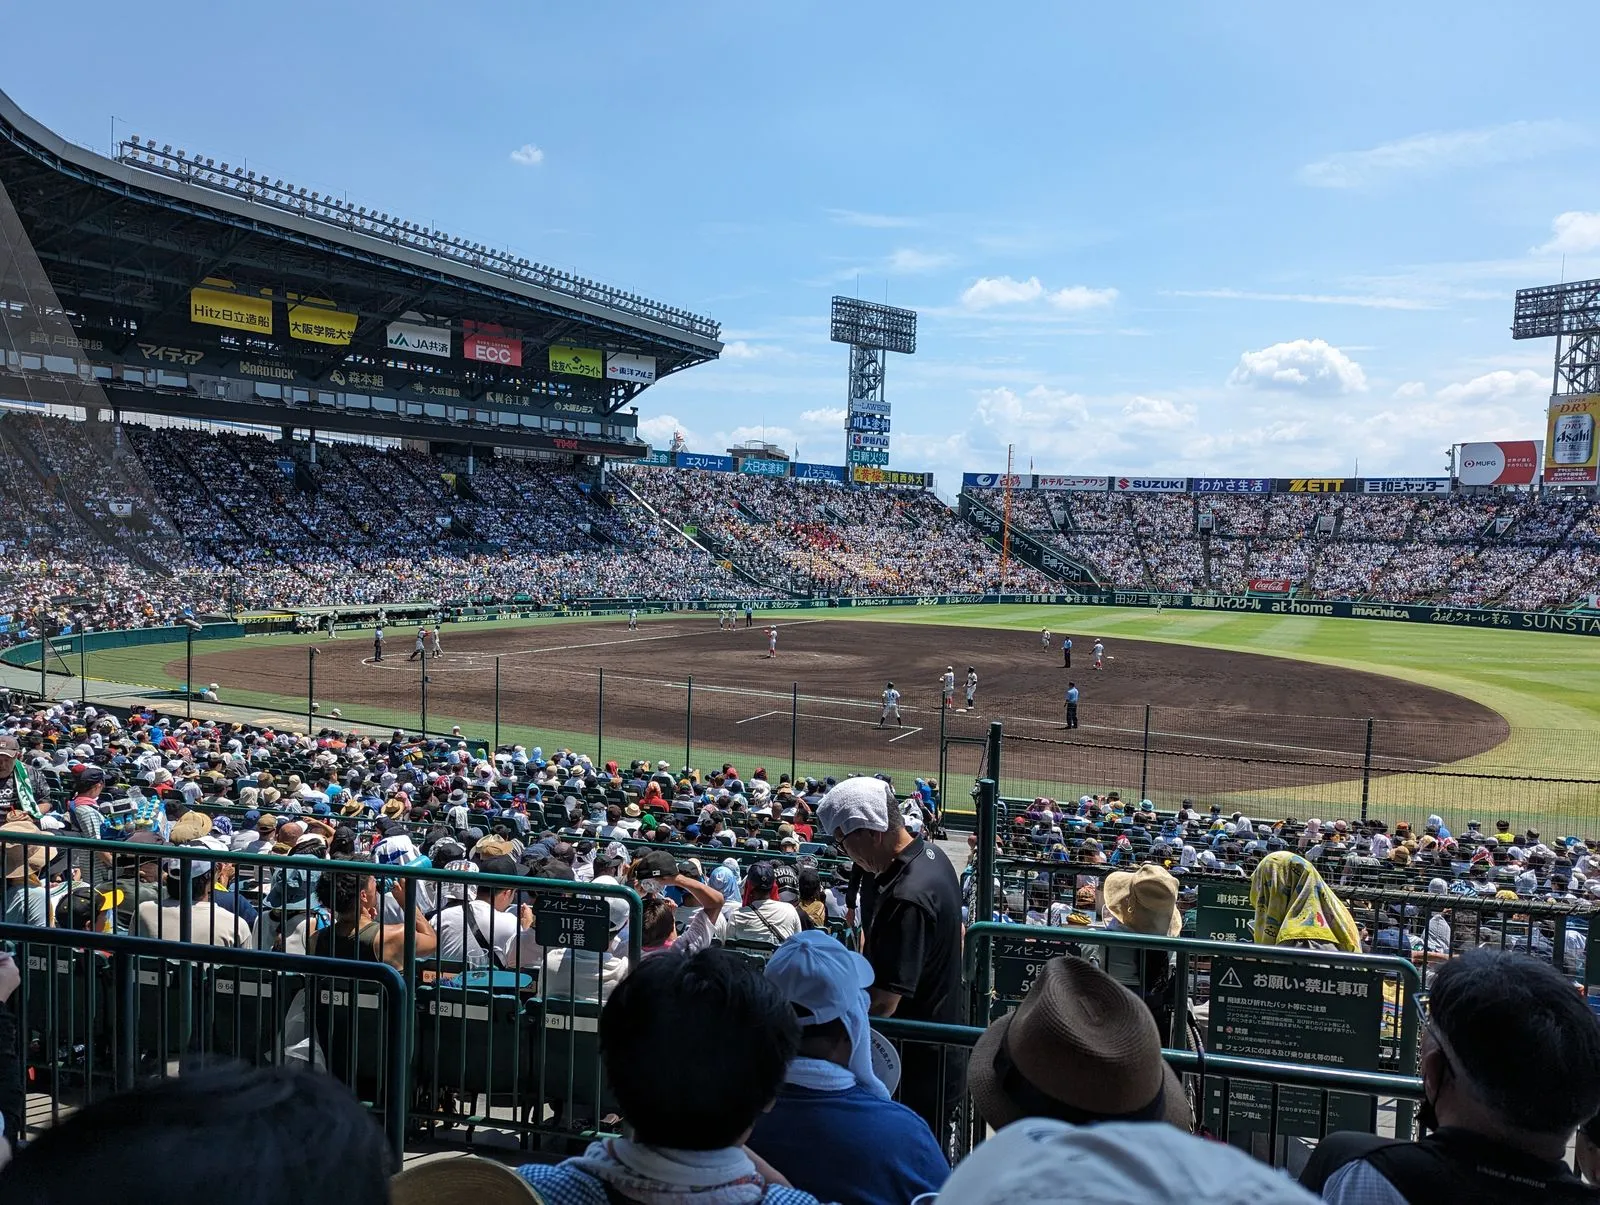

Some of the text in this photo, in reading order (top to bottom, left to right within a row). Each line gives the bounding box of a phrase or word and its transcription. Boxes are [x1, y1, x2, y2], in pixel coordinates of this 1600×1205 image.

[194, 304, 270, 328] Hitz日立造船
[412, 340, 448, 353] JA共済
[137, 343, 204, 364] マイティア
[476, 345, 510, 362] ECC
[240, 360, 294, 380] HARDLOCK
[552, 361, 600, 376] 住友ベークライト
[620, 367, 654, 378] 東洋アルミ
[348, 371, 384, 387] 森本組
[862, 402, 890, 412] LAWSON
[854, 416, 890, 431] 川上塗料
[862, 436, 888, 446] 伊藤ハム
[1556, 429, 1590, 442] Asahi
[686, 456, 724, 468] エスリード
[852, 450, 887, 464] 日新火災
[744, 460, 784, 474] 大日本塗料
[811, 468, 837, 480] ろうきん
[1040, 478, 1106, 487] ホテルニューアワジ
[1132, 480, 1184, 489] SUZUKI
[1200, 480, 1264, 492] わかさ生活
[1288, 480, 1345, 492] ZETT
[968, 506, 1000, 532] 大同生命
[742, 602, 768, 610] GUNZE
[1074, 595, 1110, 604] 住友電工
[1191, 596, 1262, 610] 東進ハイスクール
[1272, 600, 1333, 614] at home
[544, 900, 602, 912] アイビーシート
[1216, 894, 1252, 906] 車椅子
[560, 918, 585, 932] 11段
[558, 932, 586, 946] 61番
[1004, 944, 1073, 958] アイビーシート
[1253, 973, 1368, 998] お願い・禁止事項
[440, 1005, 449, 1014] 62
[552, 1018, 560, 1026] 61
